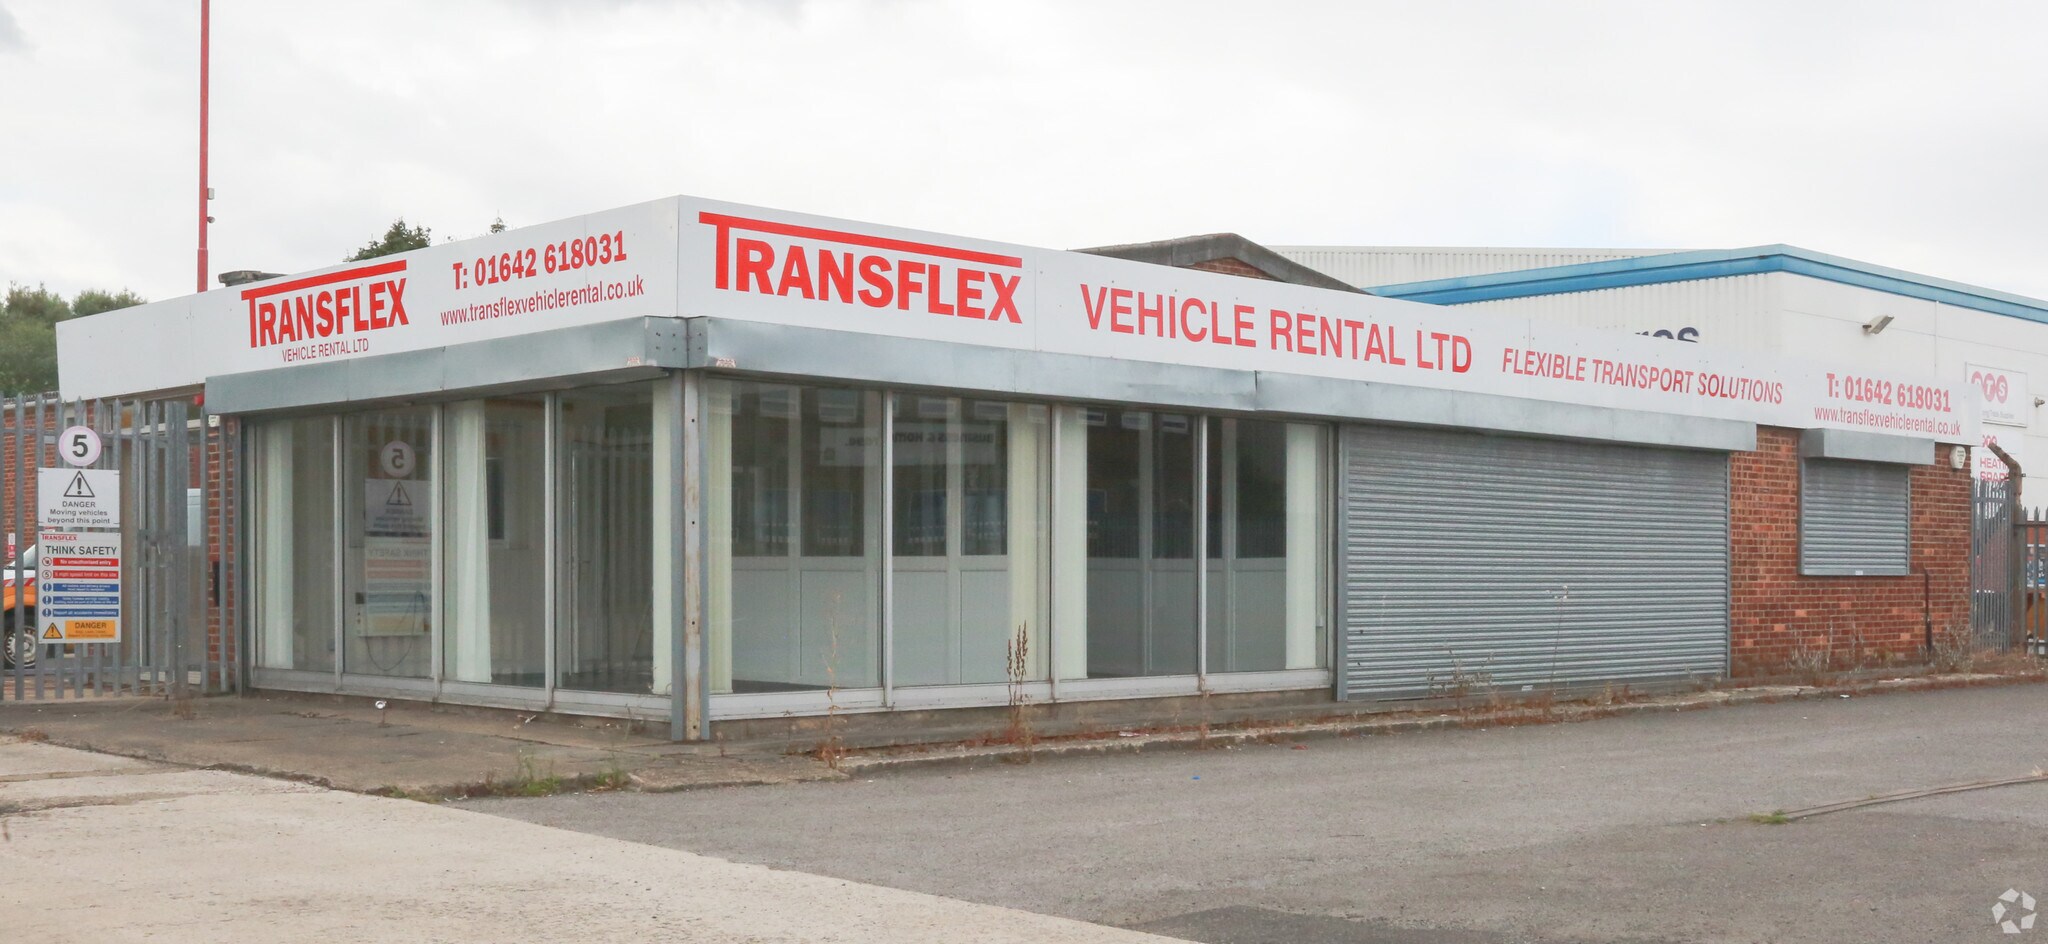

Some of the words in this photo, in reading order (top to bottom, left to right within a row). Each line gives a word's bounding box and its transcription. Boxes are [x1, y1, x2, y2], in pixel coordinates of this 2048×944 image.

[453, 262, 468, 290] T:
[474, 248, 537, 287] 01642
[544, 230, 627, 274] 618031
[698, 211, 1023, 324] TRANSFLEX
[240, 259, 410, 348] TRANSFLEX
[440, 273, 645, 326] www.transflexvehiclerental.co.uk
[282, 345, 317, 362] VEHICLE
[318, 341, 351, 357] RENTAL
[352, 337, 369, 352] LTD
[1080, 283, 1257, 348] VEHICLE
[1270, 308, 1406, 366] RENTAL
[1416, 329, 1472, 374] LTD
[1502, 347, 1587, 382] FLEXIBLE
[1592, 358, 1694, 394] TRANSPORT
[1697, 372, 1784, 405] SOLUTIONS
[1826, 372, 1839, 398] T:
[1844, 375, 1892, 405] 01642
[1897, 383, 1951, 412] 618031
[1814, 406, 1961, 436] www.transflexvehiclerental.co.uk
[72, 434, 88, 458] 5
[41, 533, 77, 541] TRANSFLEX
[45, 545, 76, 555] THINK
[78, 546, 117, 555] SAFETY
